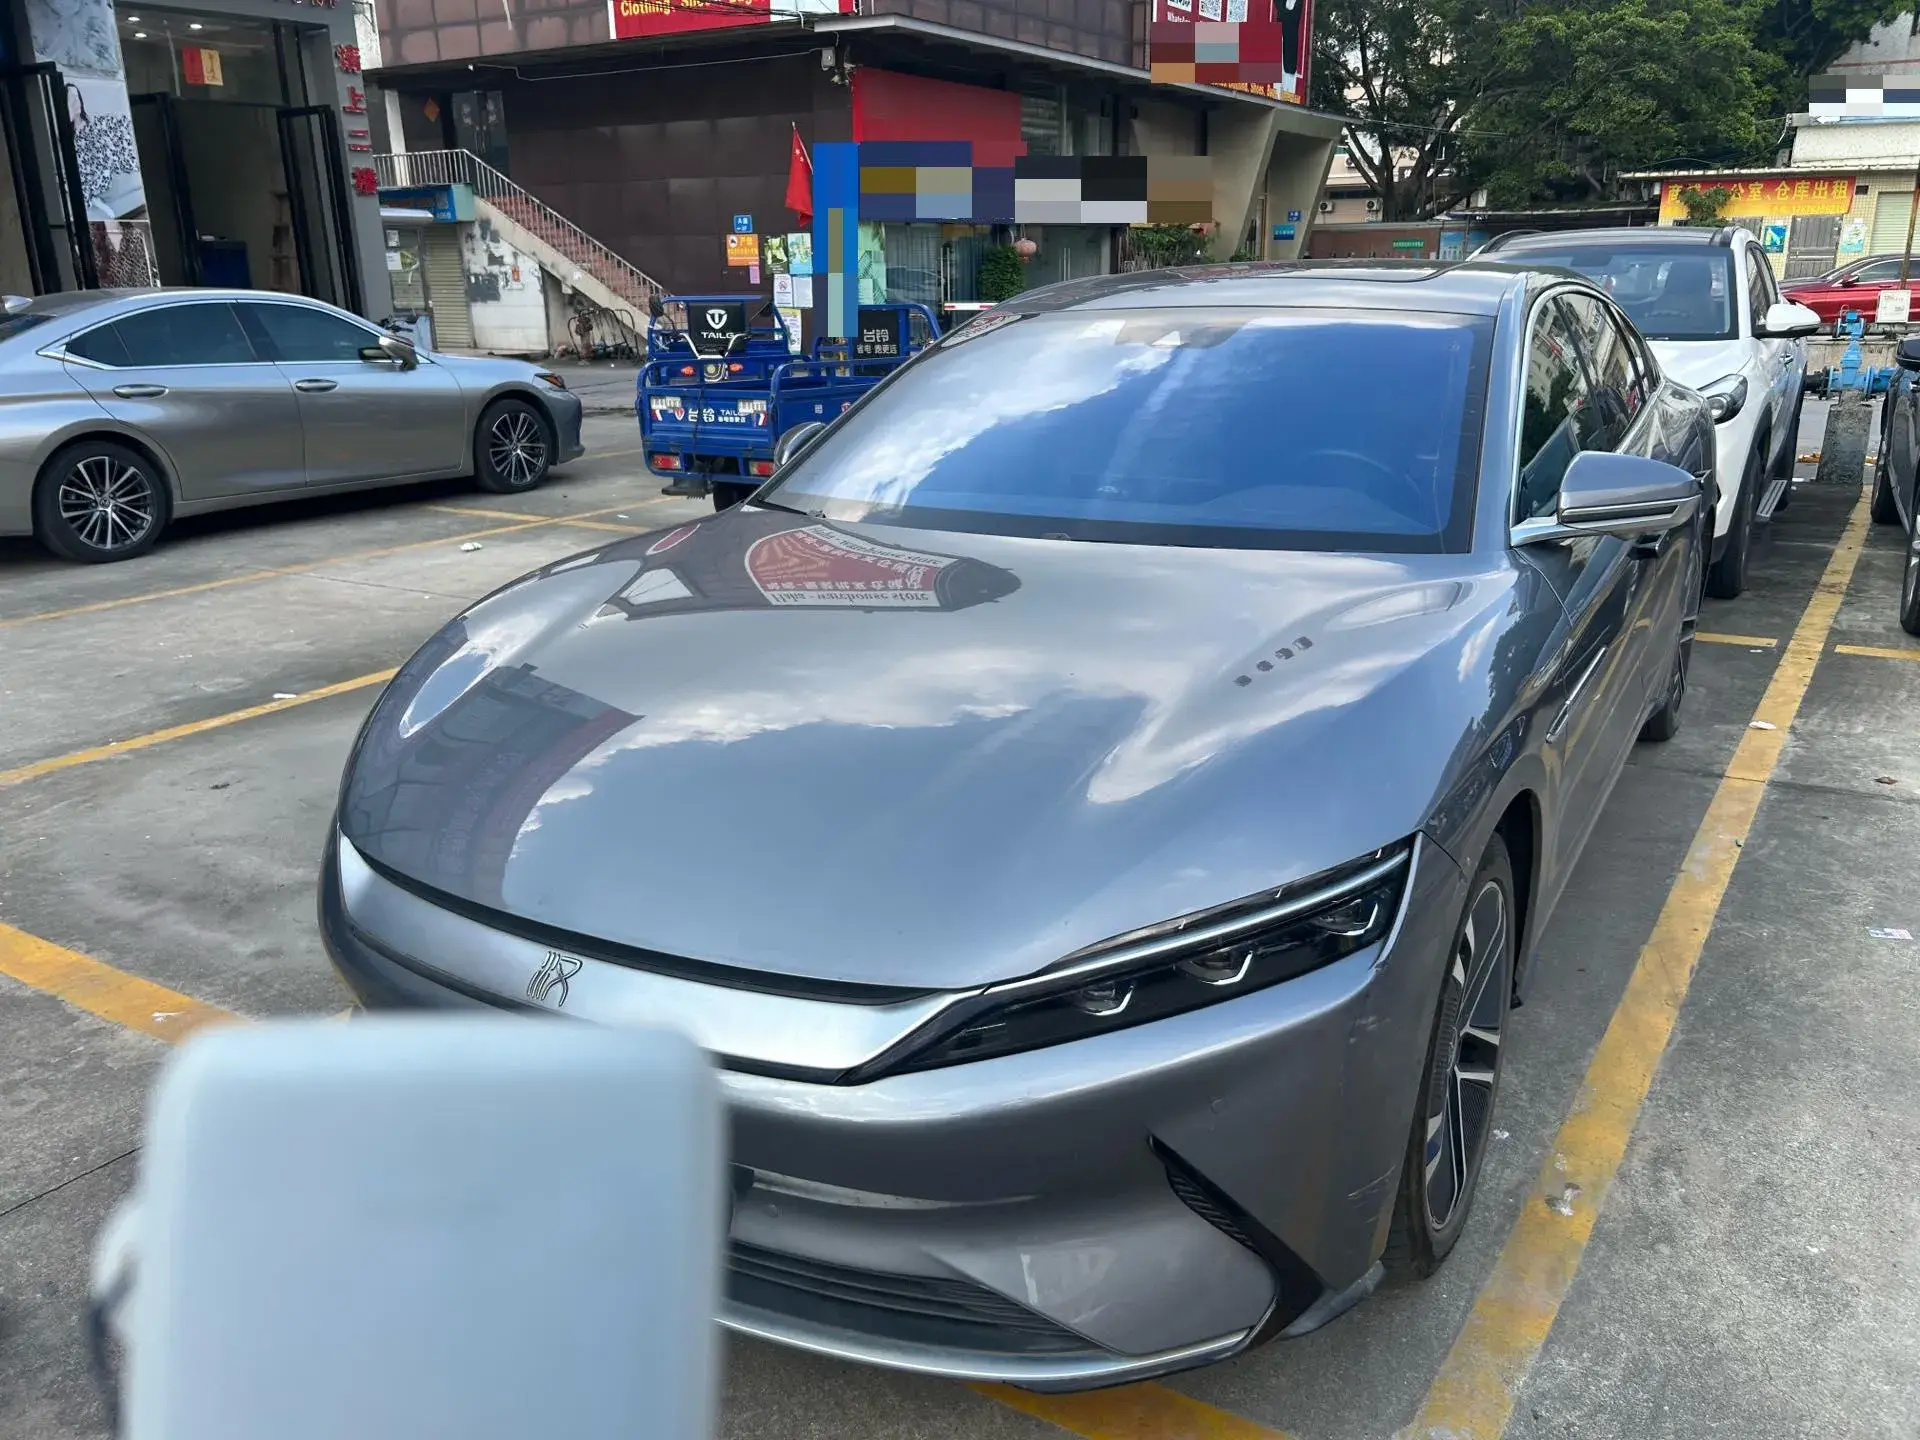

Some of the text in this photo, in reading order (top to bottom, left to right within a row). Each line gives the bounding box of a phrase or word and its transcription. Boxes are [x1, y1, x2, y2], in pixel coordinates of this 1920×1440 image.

[1668, 179, 1849, 204] 商公室、仓库出租
